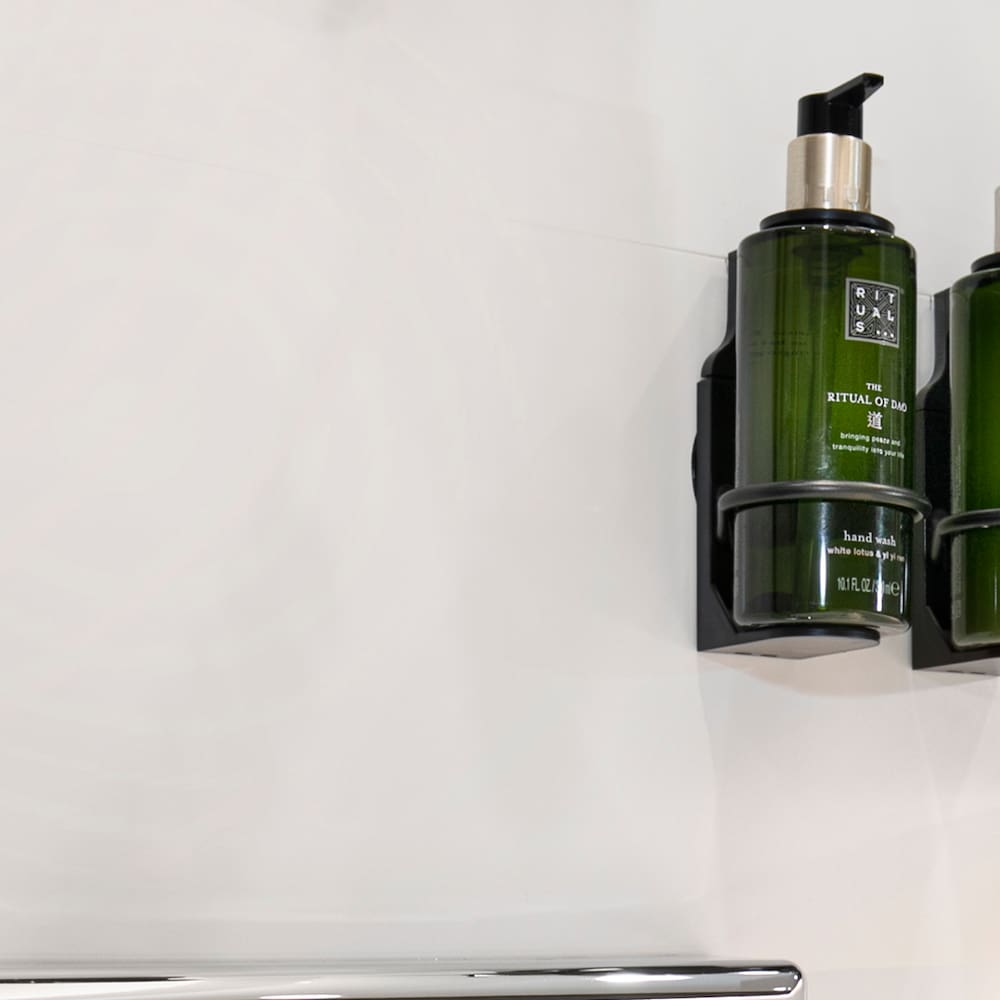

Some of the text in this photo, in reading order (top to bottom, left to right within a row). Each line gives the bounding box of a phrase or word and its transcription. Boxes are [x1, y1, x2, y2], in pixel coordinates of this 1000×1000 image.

[866, 383, 882, 392] THE
[827, 391, 907, 412] RITUAL OF DAO
[867, 411, 882, 430] 道
[840, 432, 870, 442] bringing
[832, 443, 869, 454] tranquility
[843, 530, 896, 547] hand wash
[827, 546, 851, 555] white
[854, 546, 874, 557] lotus
